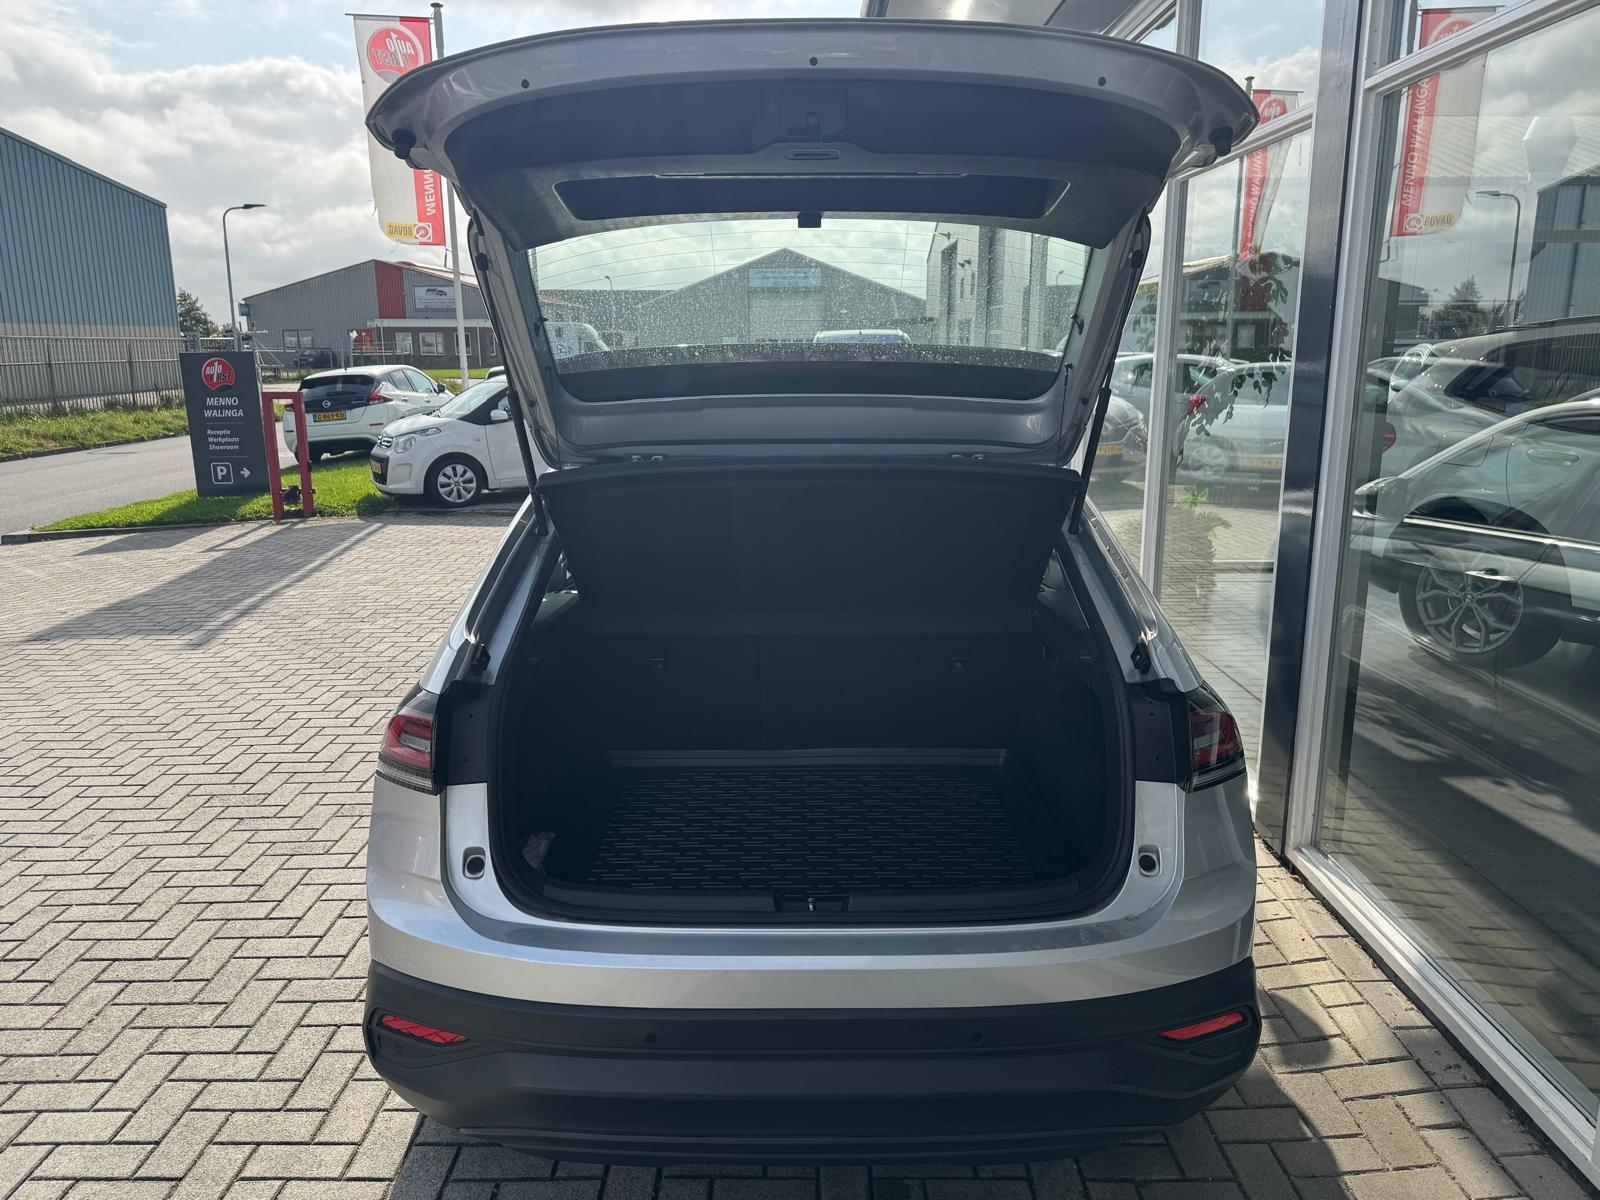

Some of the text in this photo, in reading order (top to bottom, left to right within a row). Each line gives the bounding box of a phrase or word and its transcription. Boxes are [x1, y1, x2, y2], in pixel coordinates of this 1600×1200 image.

[1251, 148, 1264, 195] WALING
[1401, 153, 1419, 207] MENNO
[206, 397, 239, 406] MENNO
[204, 409, 244, 418] WALINGA
[217, 466, 227, 480] P
